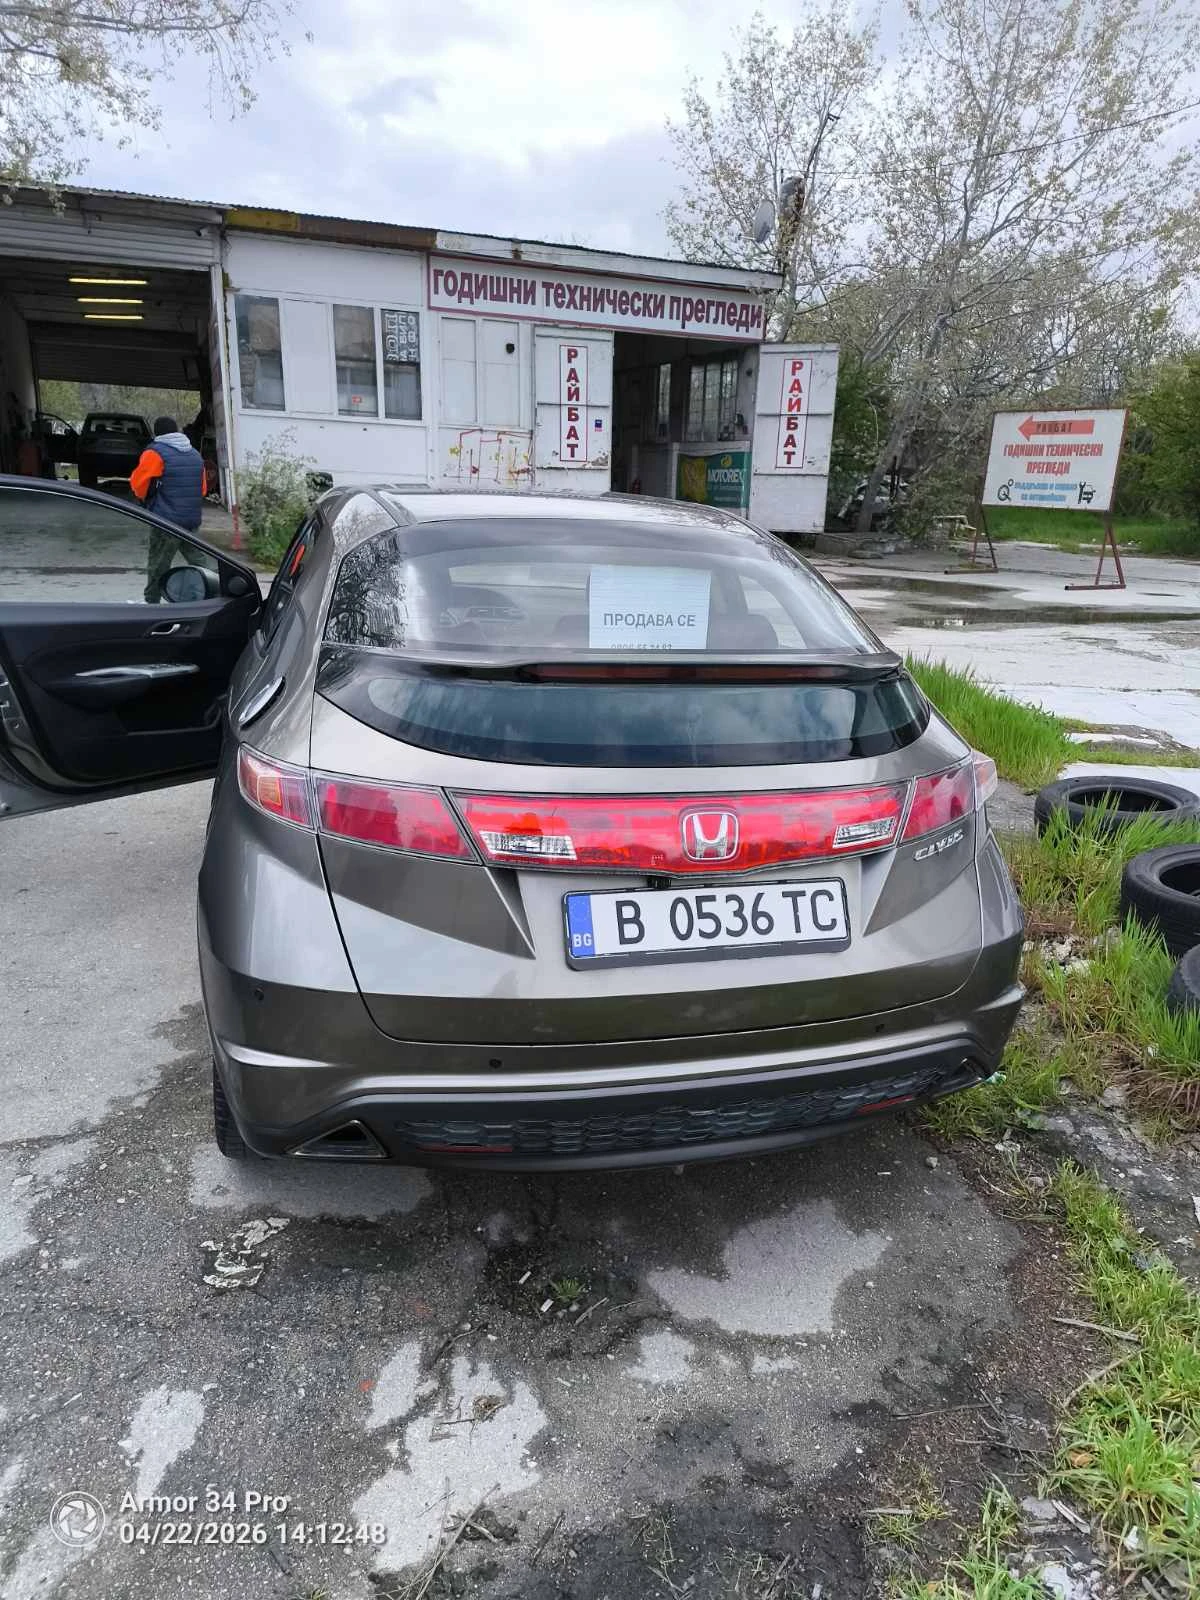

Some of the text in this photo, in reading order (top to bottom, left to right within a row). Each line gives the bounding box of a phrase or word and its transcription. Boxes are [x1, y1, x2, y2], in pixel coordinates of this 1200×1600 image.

[669, 294, 763, 333] прегледи
[566, 348, 580, 458] РАЙБАТ
[783, 361, 804, 465] РАЙБАТ
[1026, 461, 1070, 476] ПРЕГЛЕДИ
[603, 613, 696, 629] ПРОДАВА СЕ
[615, 889, 837, 945] B 0536 TC
[572, 933, 592, 947] BG
